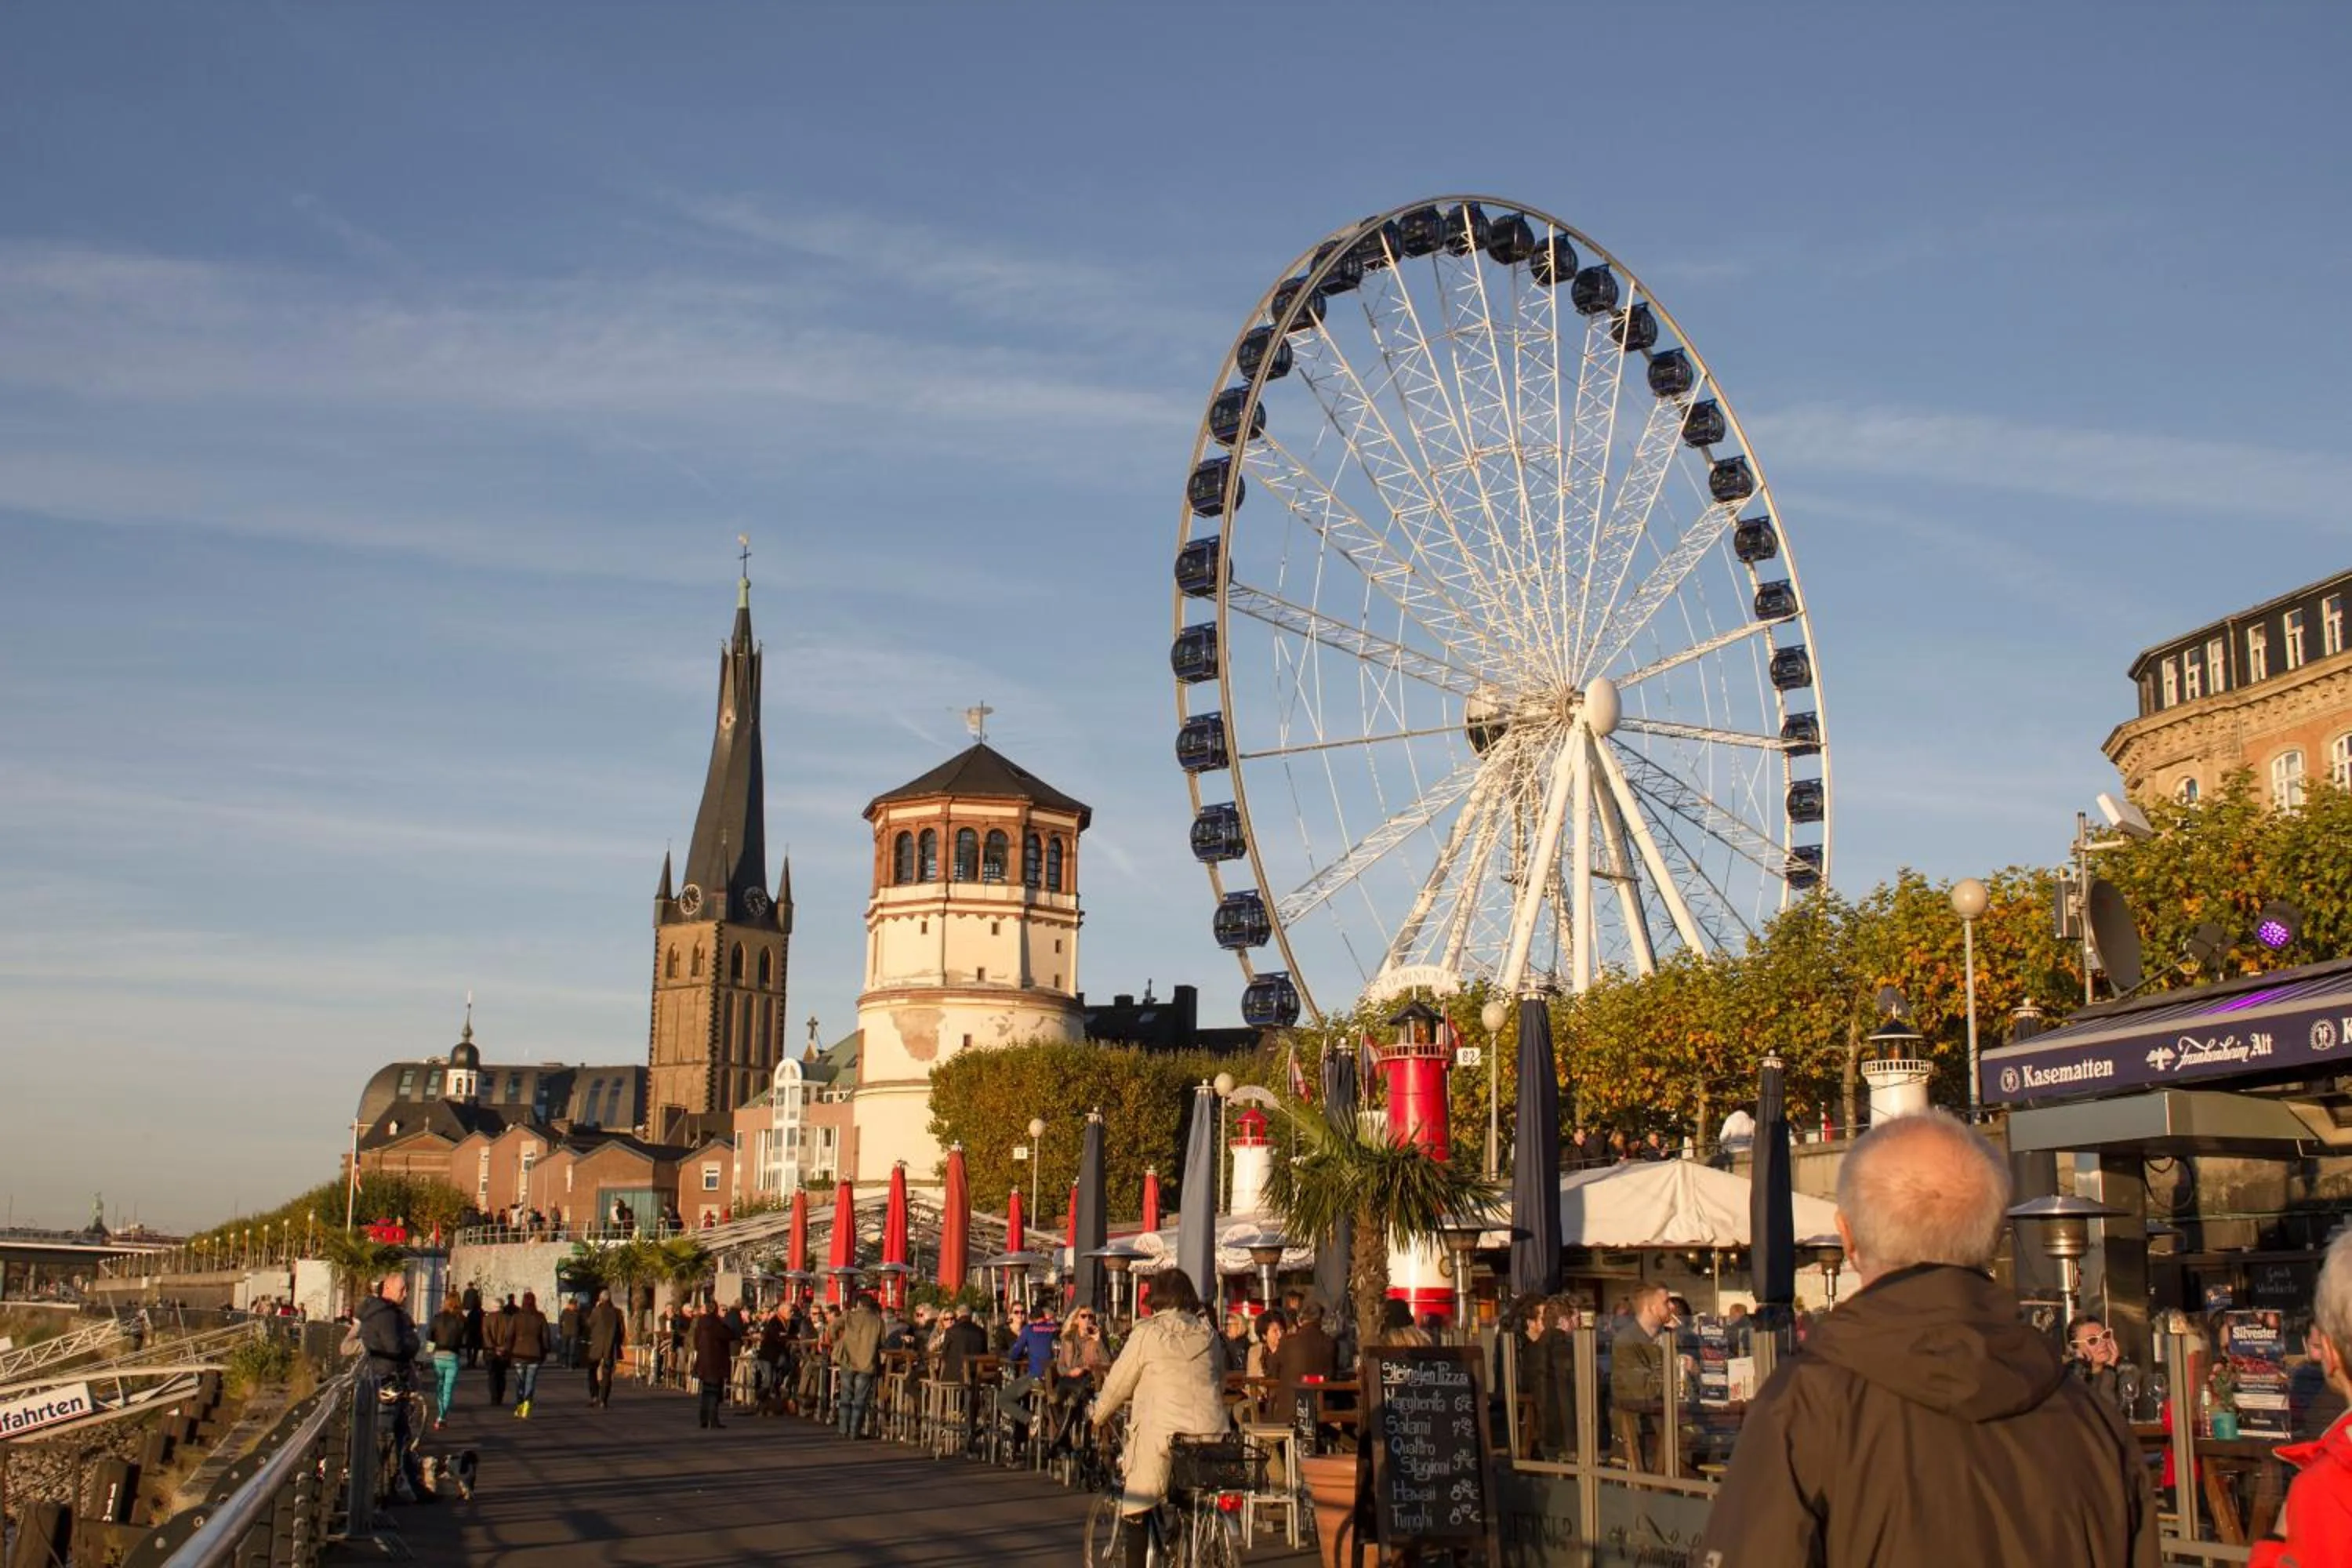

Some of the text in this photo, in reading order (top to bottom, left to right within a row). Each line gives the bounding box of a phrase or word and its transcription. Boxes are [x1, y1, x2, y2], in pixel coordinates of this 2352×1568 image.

[1462, 1050, 1475, 1063] 82
[2174, 1033, 2273, 1071] Frankenheim Alt
[2022, 1058, 2114, 1088] Kasematten
[2232, 1326, 2278, 1340] Silvester
[1432, 1361, 1468, 1385] Pizza
[1384, 1387, 1445, 1414] Margherita
[0, 1396, 84, 1432] fahrten
[1385, 1414, 1432, 1436] Salami
[1391, 1436, 1436, 1456] Quattro
[1399, 1456, 1450, 1481] Stagioni
[1392, 1480, 1436, 1501] Hawaii
